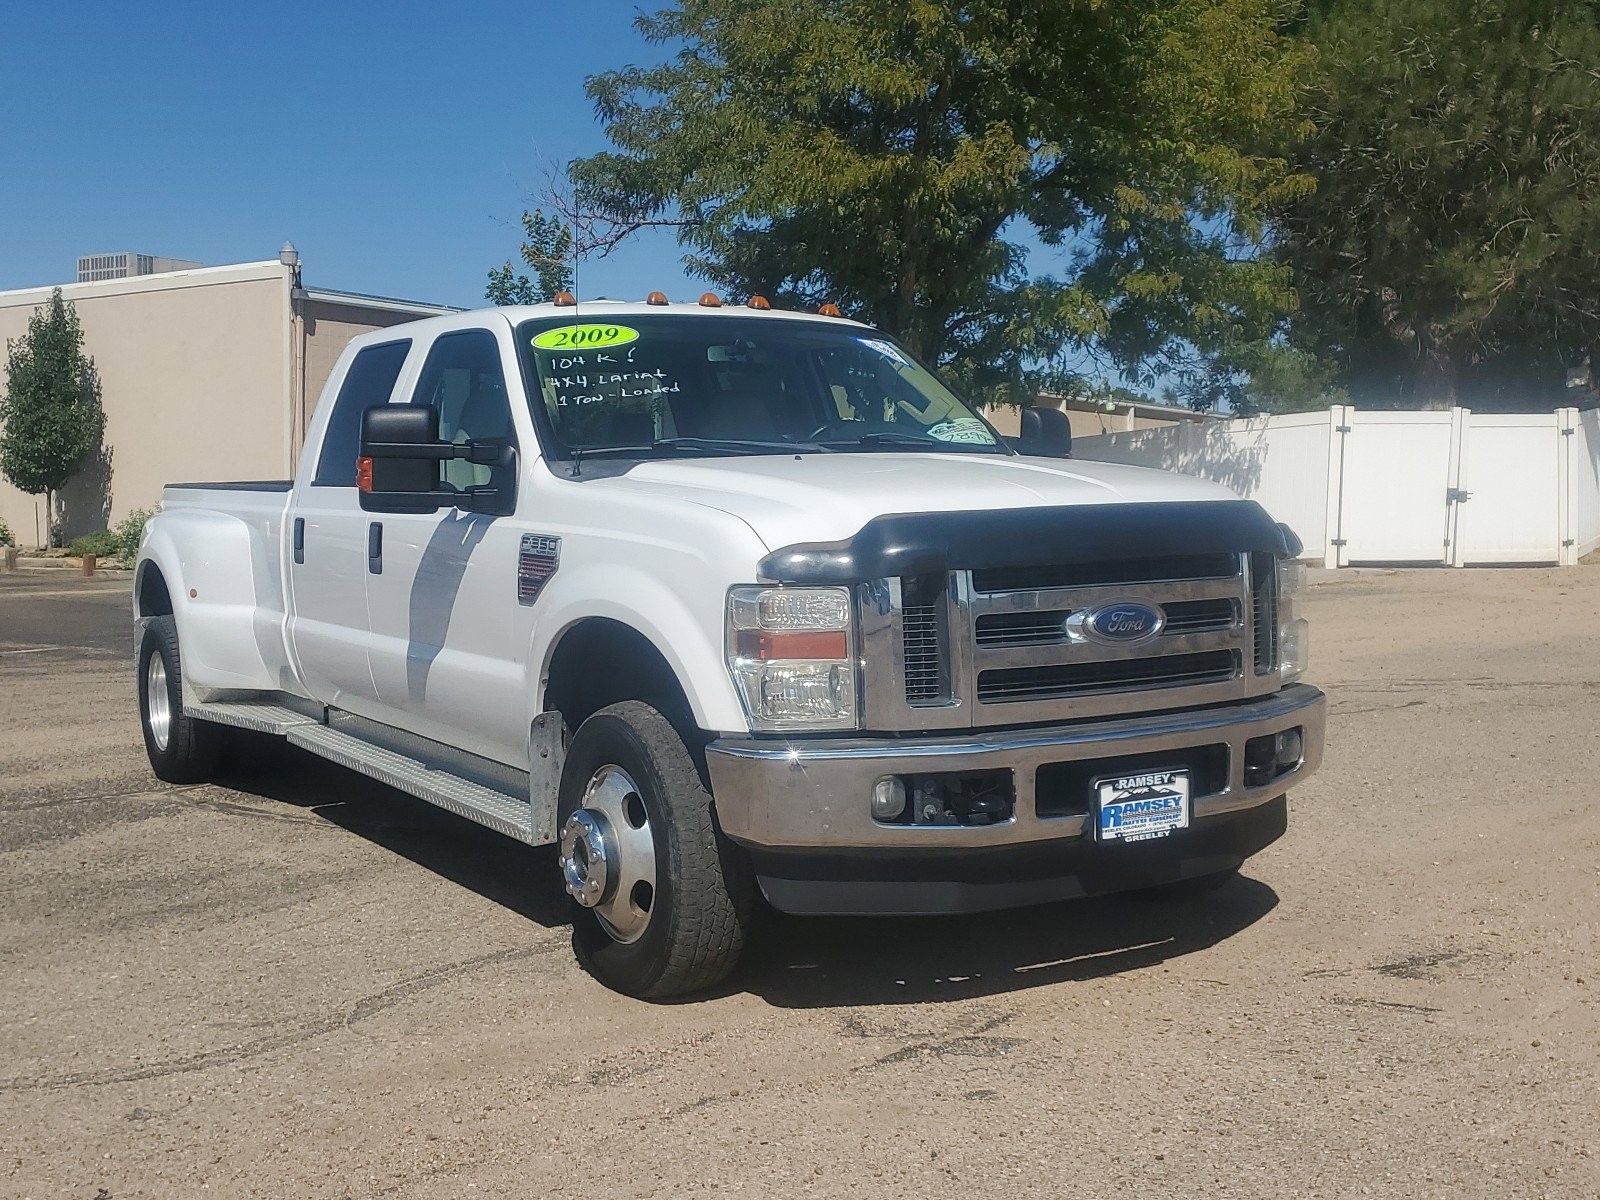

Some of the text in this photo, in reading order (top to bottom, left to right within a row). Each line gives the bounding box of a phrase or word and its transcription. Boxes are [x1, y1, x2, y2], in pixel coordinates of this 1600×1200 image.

[553, 327, 619, 347] 2009
[551, 356, 586, 370] 104
[1108, 611, 1146, 633] Ford
[1119, 773, 1171, 790] RAMSEY
[1102, 796, 1183, 828] RAMSEY
[1122, 817, 1148, 826] AUTO
[1149, 813, 1182, 822] GROUP
[1124, 830, 1171, 842] GREELEY
